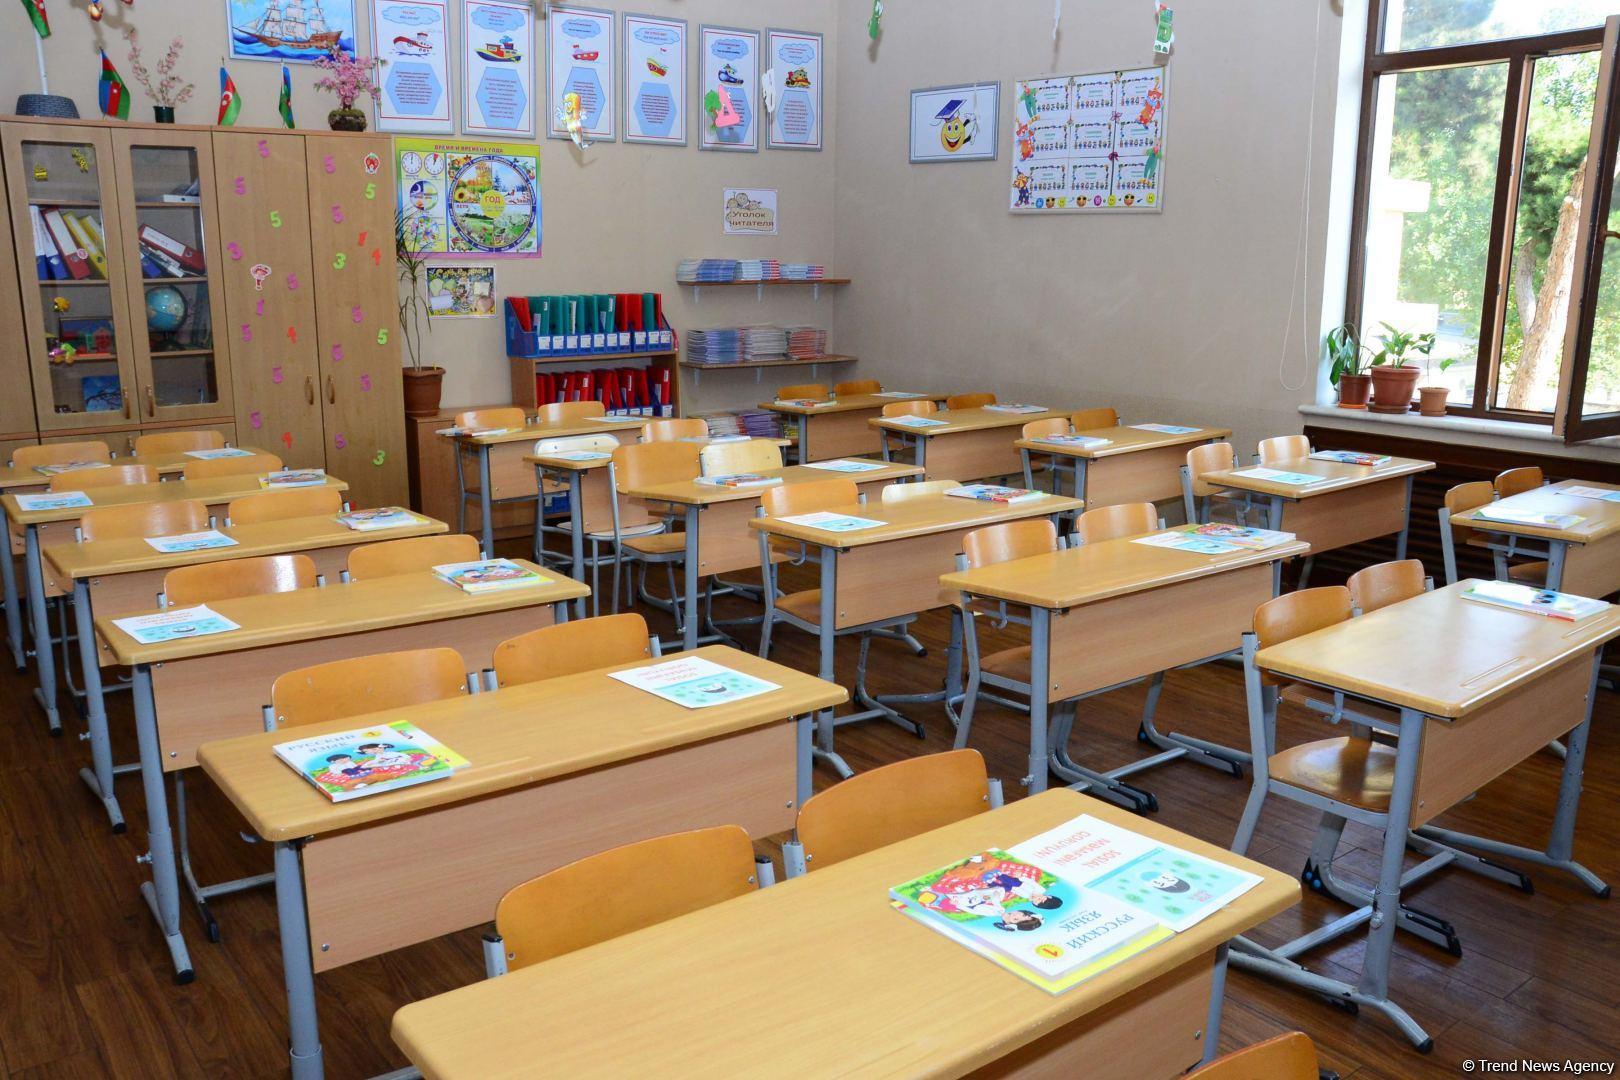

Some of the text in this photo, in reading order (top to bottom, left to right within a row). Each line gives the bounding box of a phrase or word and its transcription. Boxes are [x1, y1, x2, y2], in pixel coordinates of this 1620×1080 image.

[364, 182, 376, 200] 5
[484, 195, 501, 204] ГОД
[269, 211, 283, 228] 5
[333, 252, 346, 269] 3
[378, 328, 388, 345] 5
[372, 450, 386, 465] 3
[1058, 911, 1102, 933] ЯЗЫК
[1064, 913, 1135, 950] РУССКИЙ
[1042, 947, 1058, 958] 1
